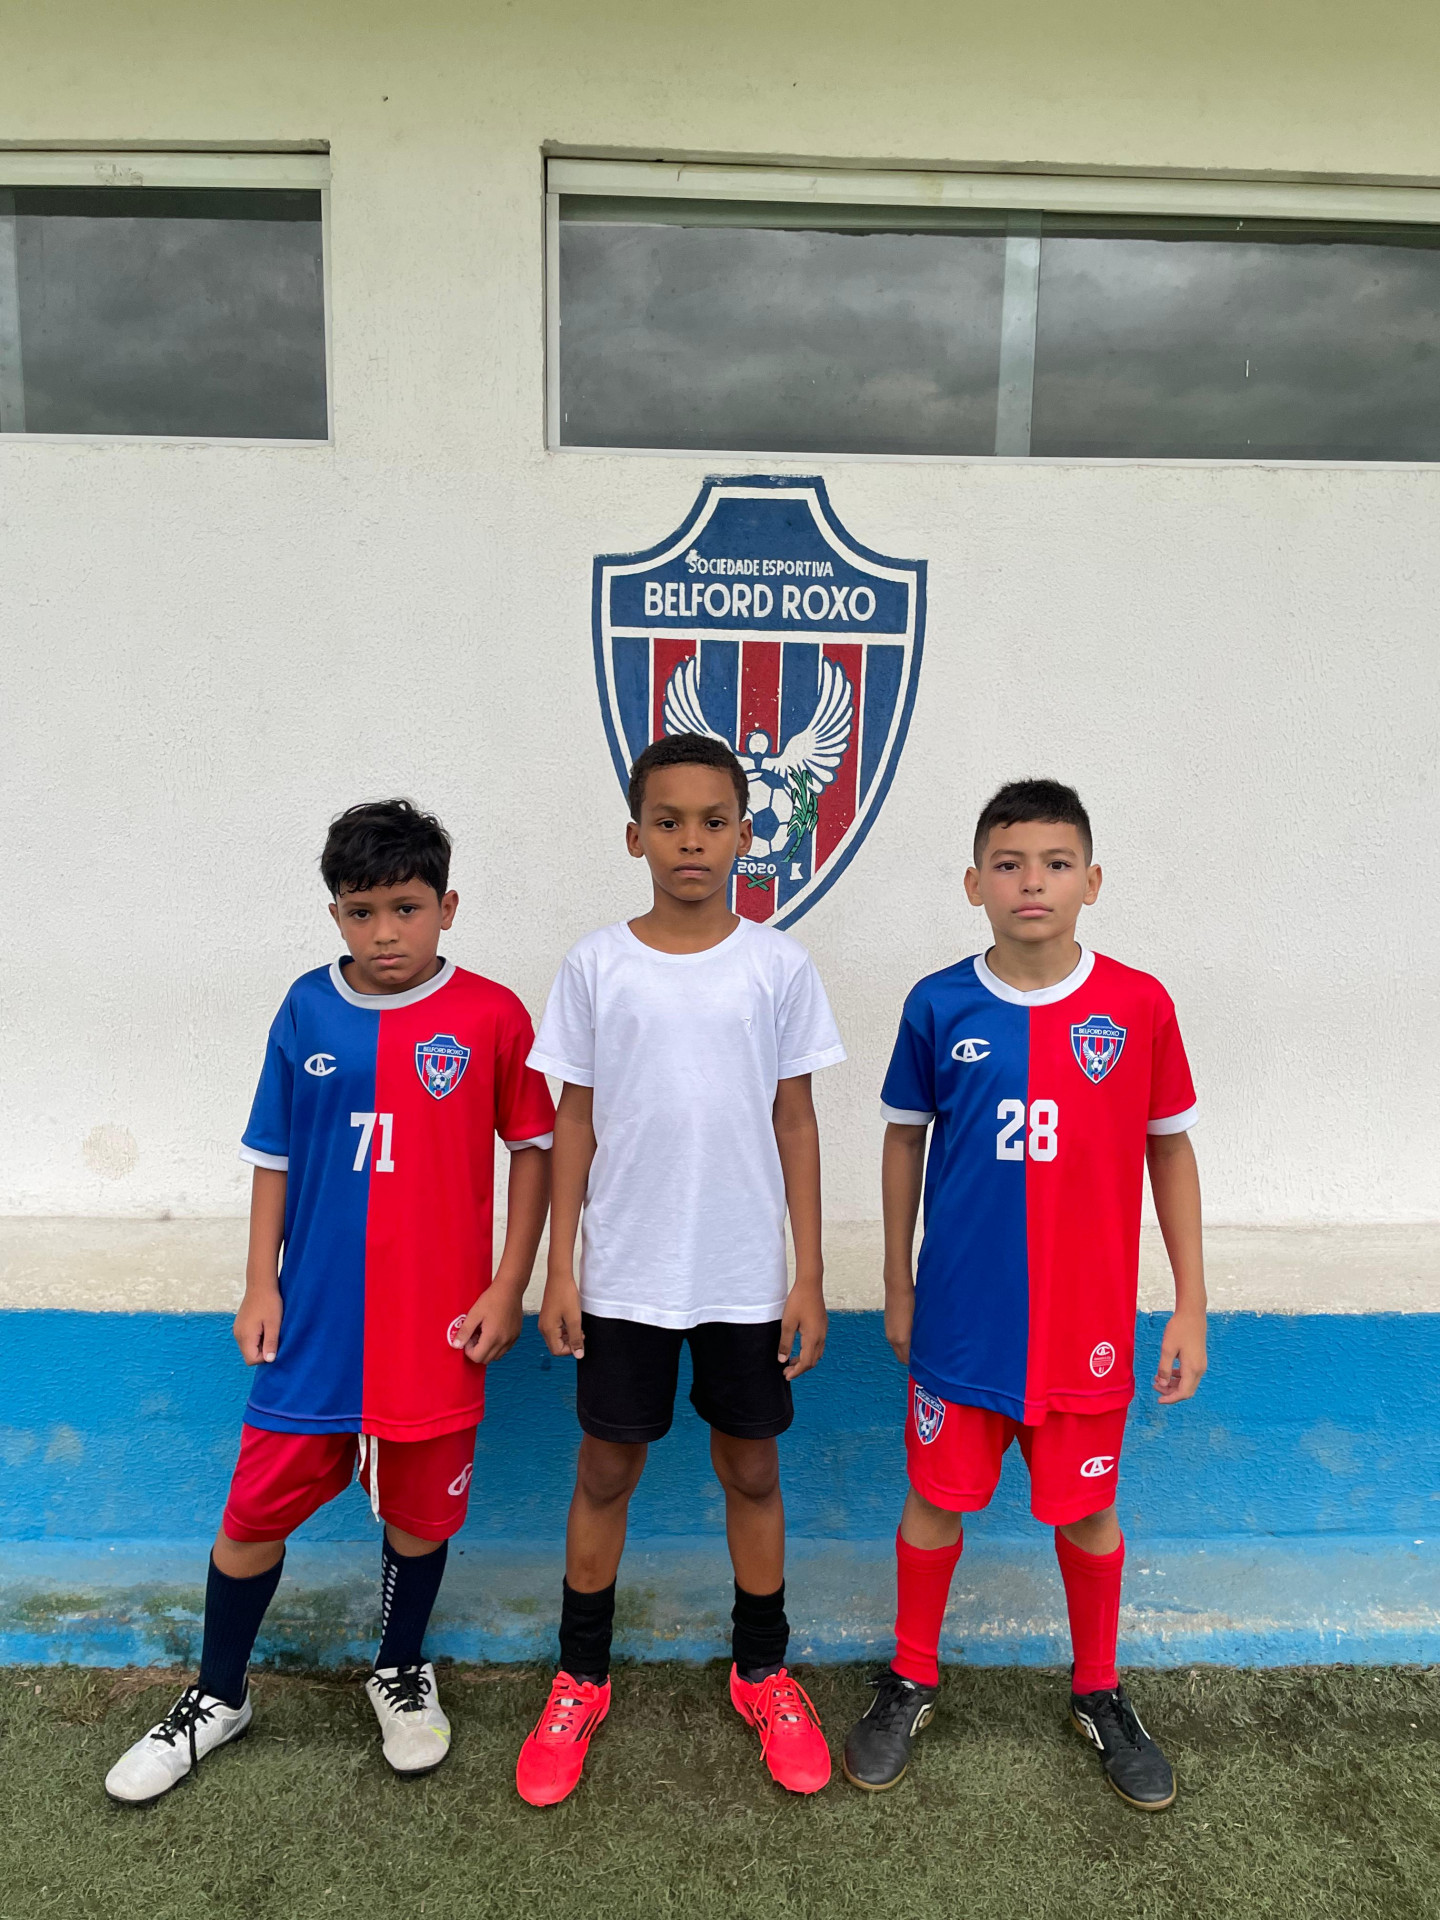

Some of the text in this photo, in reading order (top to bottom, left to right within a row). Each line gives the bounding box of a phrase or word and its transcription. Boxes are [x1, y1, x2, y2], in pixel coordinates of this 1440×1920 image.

[688, 558, 834, 577] SOCIEDADE ESPORTIVA
[644, 582, 876, 621] BELFORD ROXO
[737, 861, 777, 875] 2020
[1102, 1029, 1120, 1037] ROXO
[350, 1111, 395, 1173] 71
[996, 1098, 1059, 1162] 28
